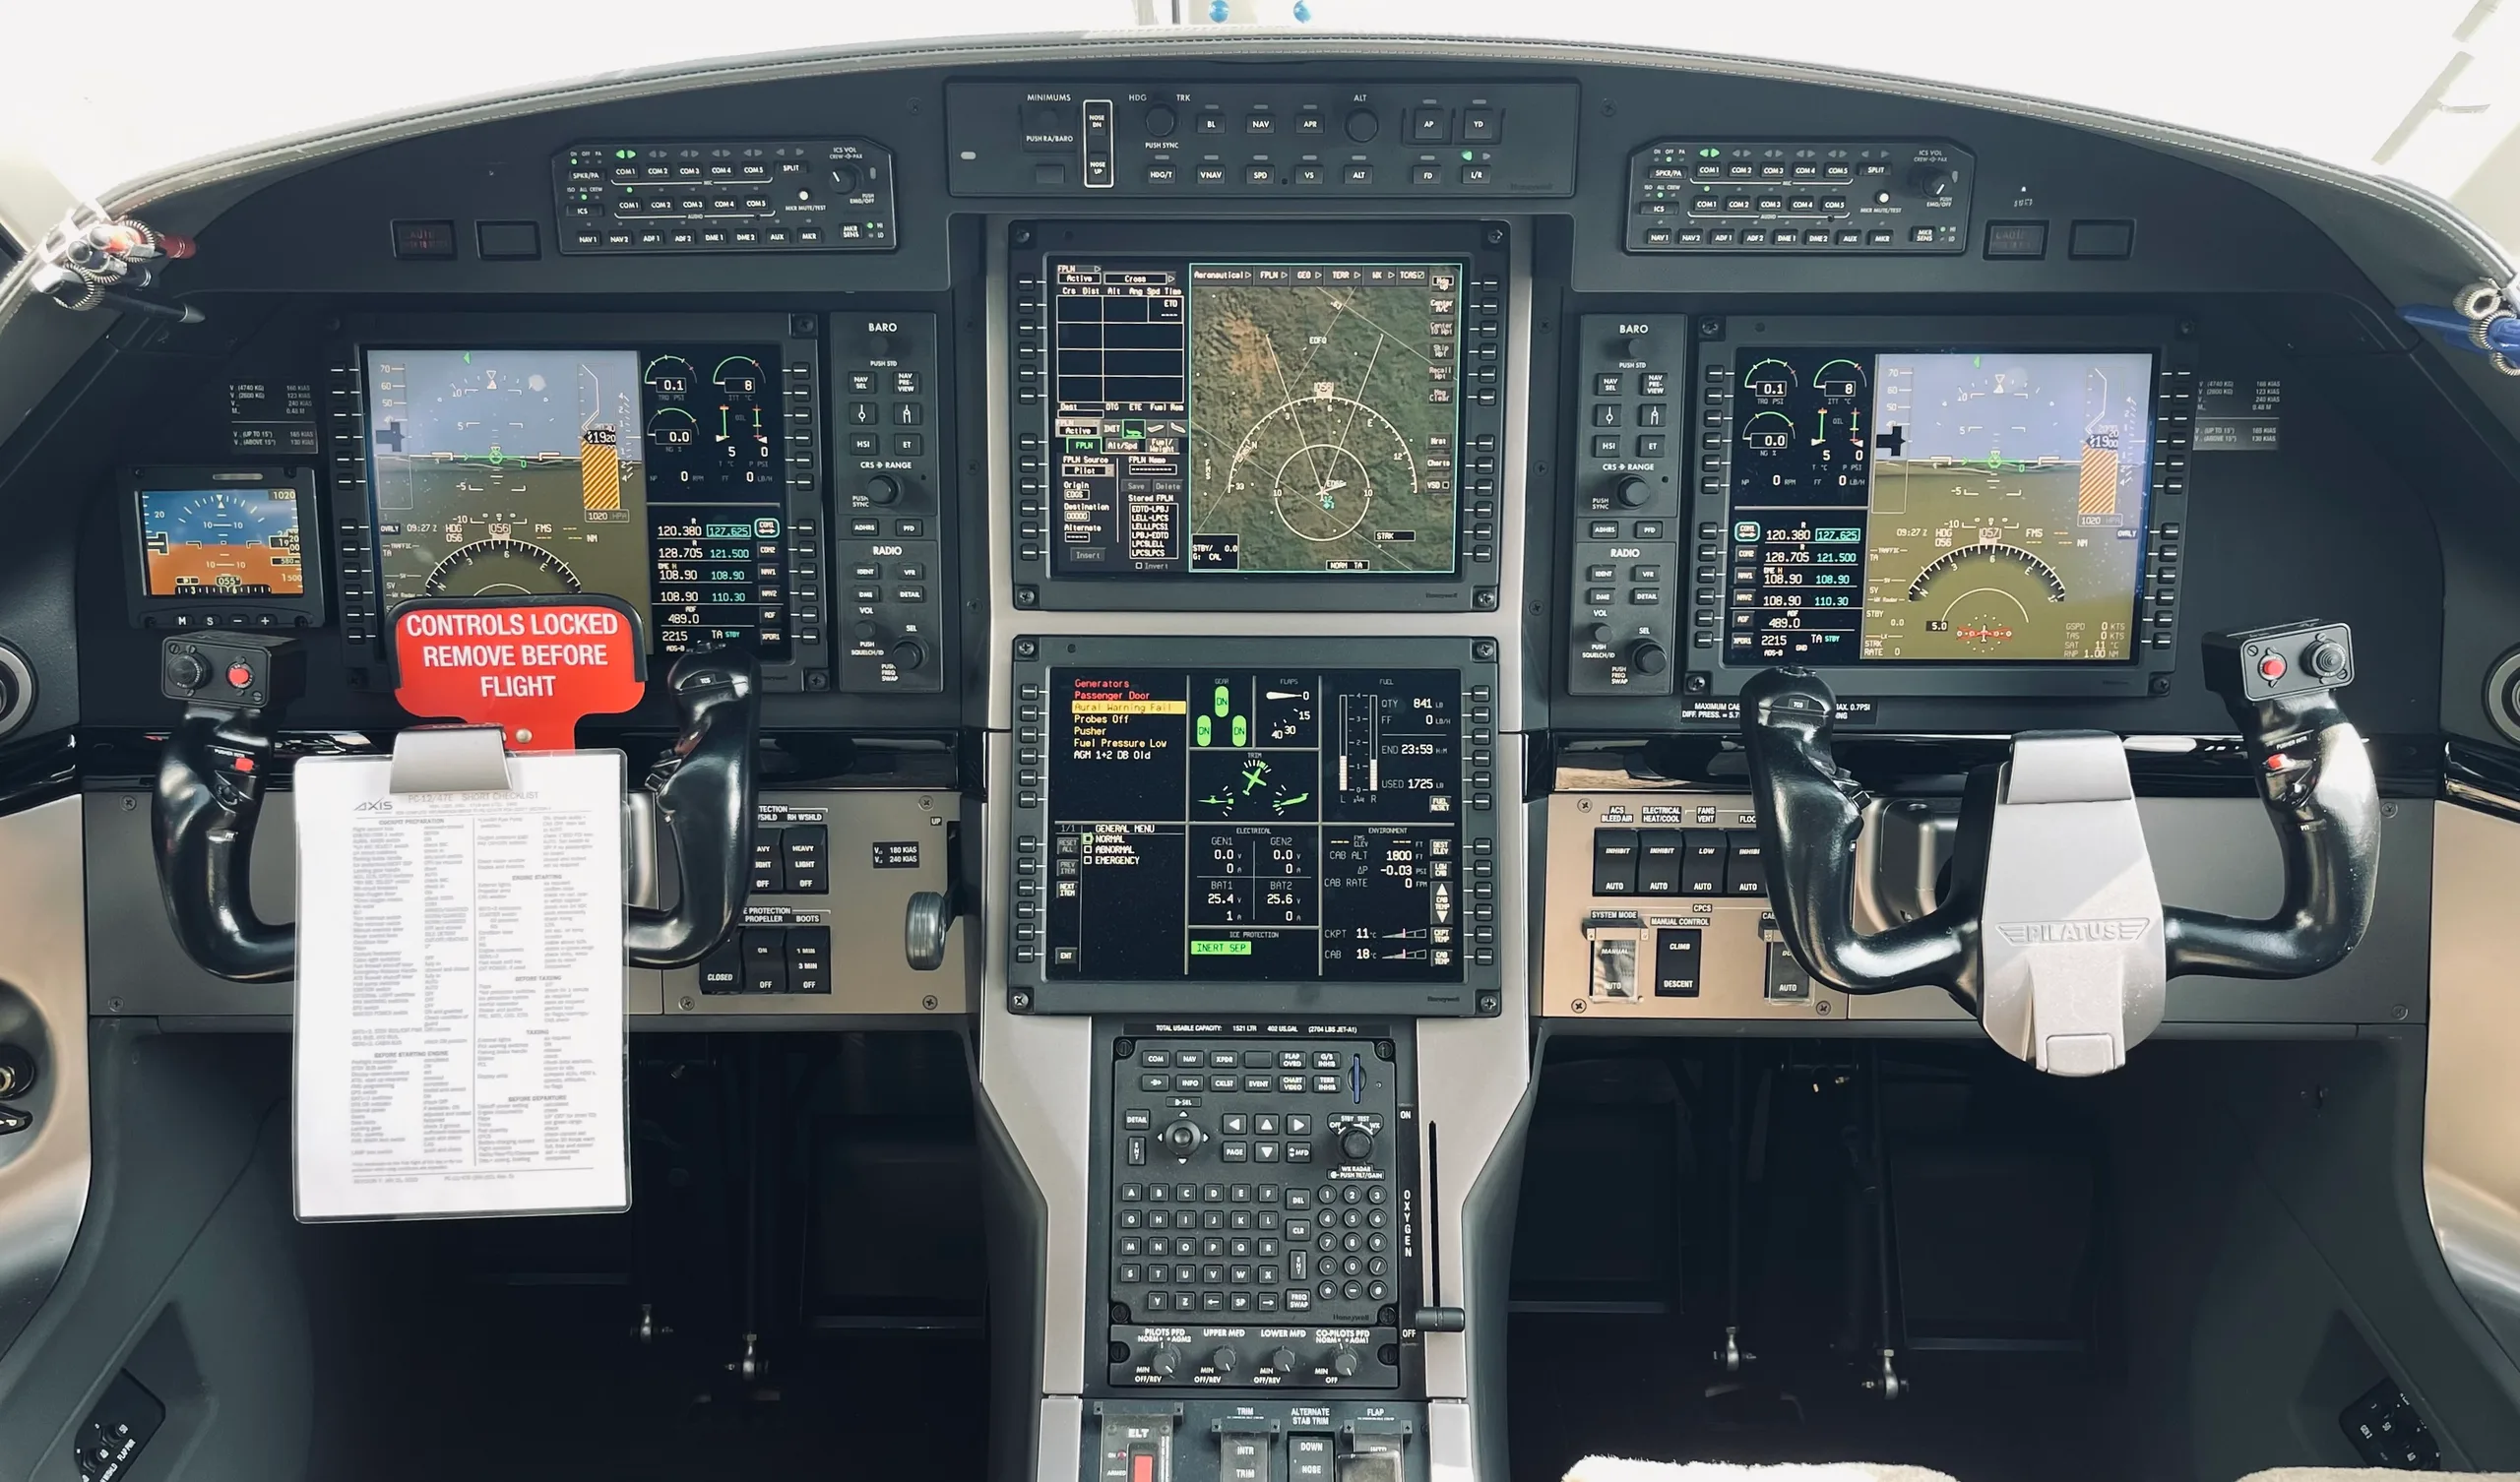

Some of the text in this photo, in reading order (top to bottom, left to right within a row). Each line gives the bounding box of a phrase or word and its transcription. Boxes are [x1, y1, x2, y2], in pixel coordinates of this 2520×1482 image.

[868, 323, 897, 332] BARO
[1619, 325, 1648, 334] BARO
[663, 380, 683, 392] 0.1
[274, 491, 295, 500] 1020
[658, 526, 749, 536] 120.380 127.625
[1766, 530, 1858, 540] 120.380 127.625
[659, 548, 749, 559] 128.705 121.500
[873, 547, 902, 556] RADIO
[1610, 549, 1640, 558] RADIO
[1766, 552, 1857, 563] 128.705 121.500
[660, 570, 744, 581] 108.90 108.90
[661, 592, 745, 602] 108.90 110.30
[668, 614, 699, 624] 489.0
[1769, 618, 1800, 628] 489.0
[407, 613, 618, 637] CONTROLS LOCKED
[662, 631, 688, 641] 2215
[1761, 636, 1787, 646] 2215
[422, 645, 608, 667] REMOVE BEFORE
[480, 676, 556, 697] FLIGHT
[1075, 679, 1130, 688] Generators
[1075, 691, 1122, 701] Passenger
[1298, 711, 1310, 720] 15
[1401, 744, 1433, 754] 23:59
[1096, 751, 1112, 760] 1+2
[1134, 751, 1151, 760] Old
[1408, 779, 1433, 788] 1725
[353, 797, 393, 811] AXIS
[1386, 851, 1413, 861] 1800
[1380, 866, 1413, 876] -0.03
[1606, 882, 1624, 891] AUTO
[1650, 882, 1668, 891] AUTO
[1208, 894, 1234, 904] 25.4
[1267, 895, 1293, 904] 25.6
[1678, 917, 1709, 926] CONTROL
[1356, 928, 1369, 939] 11
[2027, 923, 2121, 943] PILATUS
[1356, 949, 1370, 959] 18
[1401, 1110, 1412, 1119] ON
[1404, 1189, 1413, 1258] OXYGEN
[1204, 1328, 1245, 1337] UPPER MFD
[1292, 1408, 1330, 1417] ALTERNATE
[1128, 1429, 1150, 1438] ELT
[1300, 1443, 1323, 1451] DOWN
